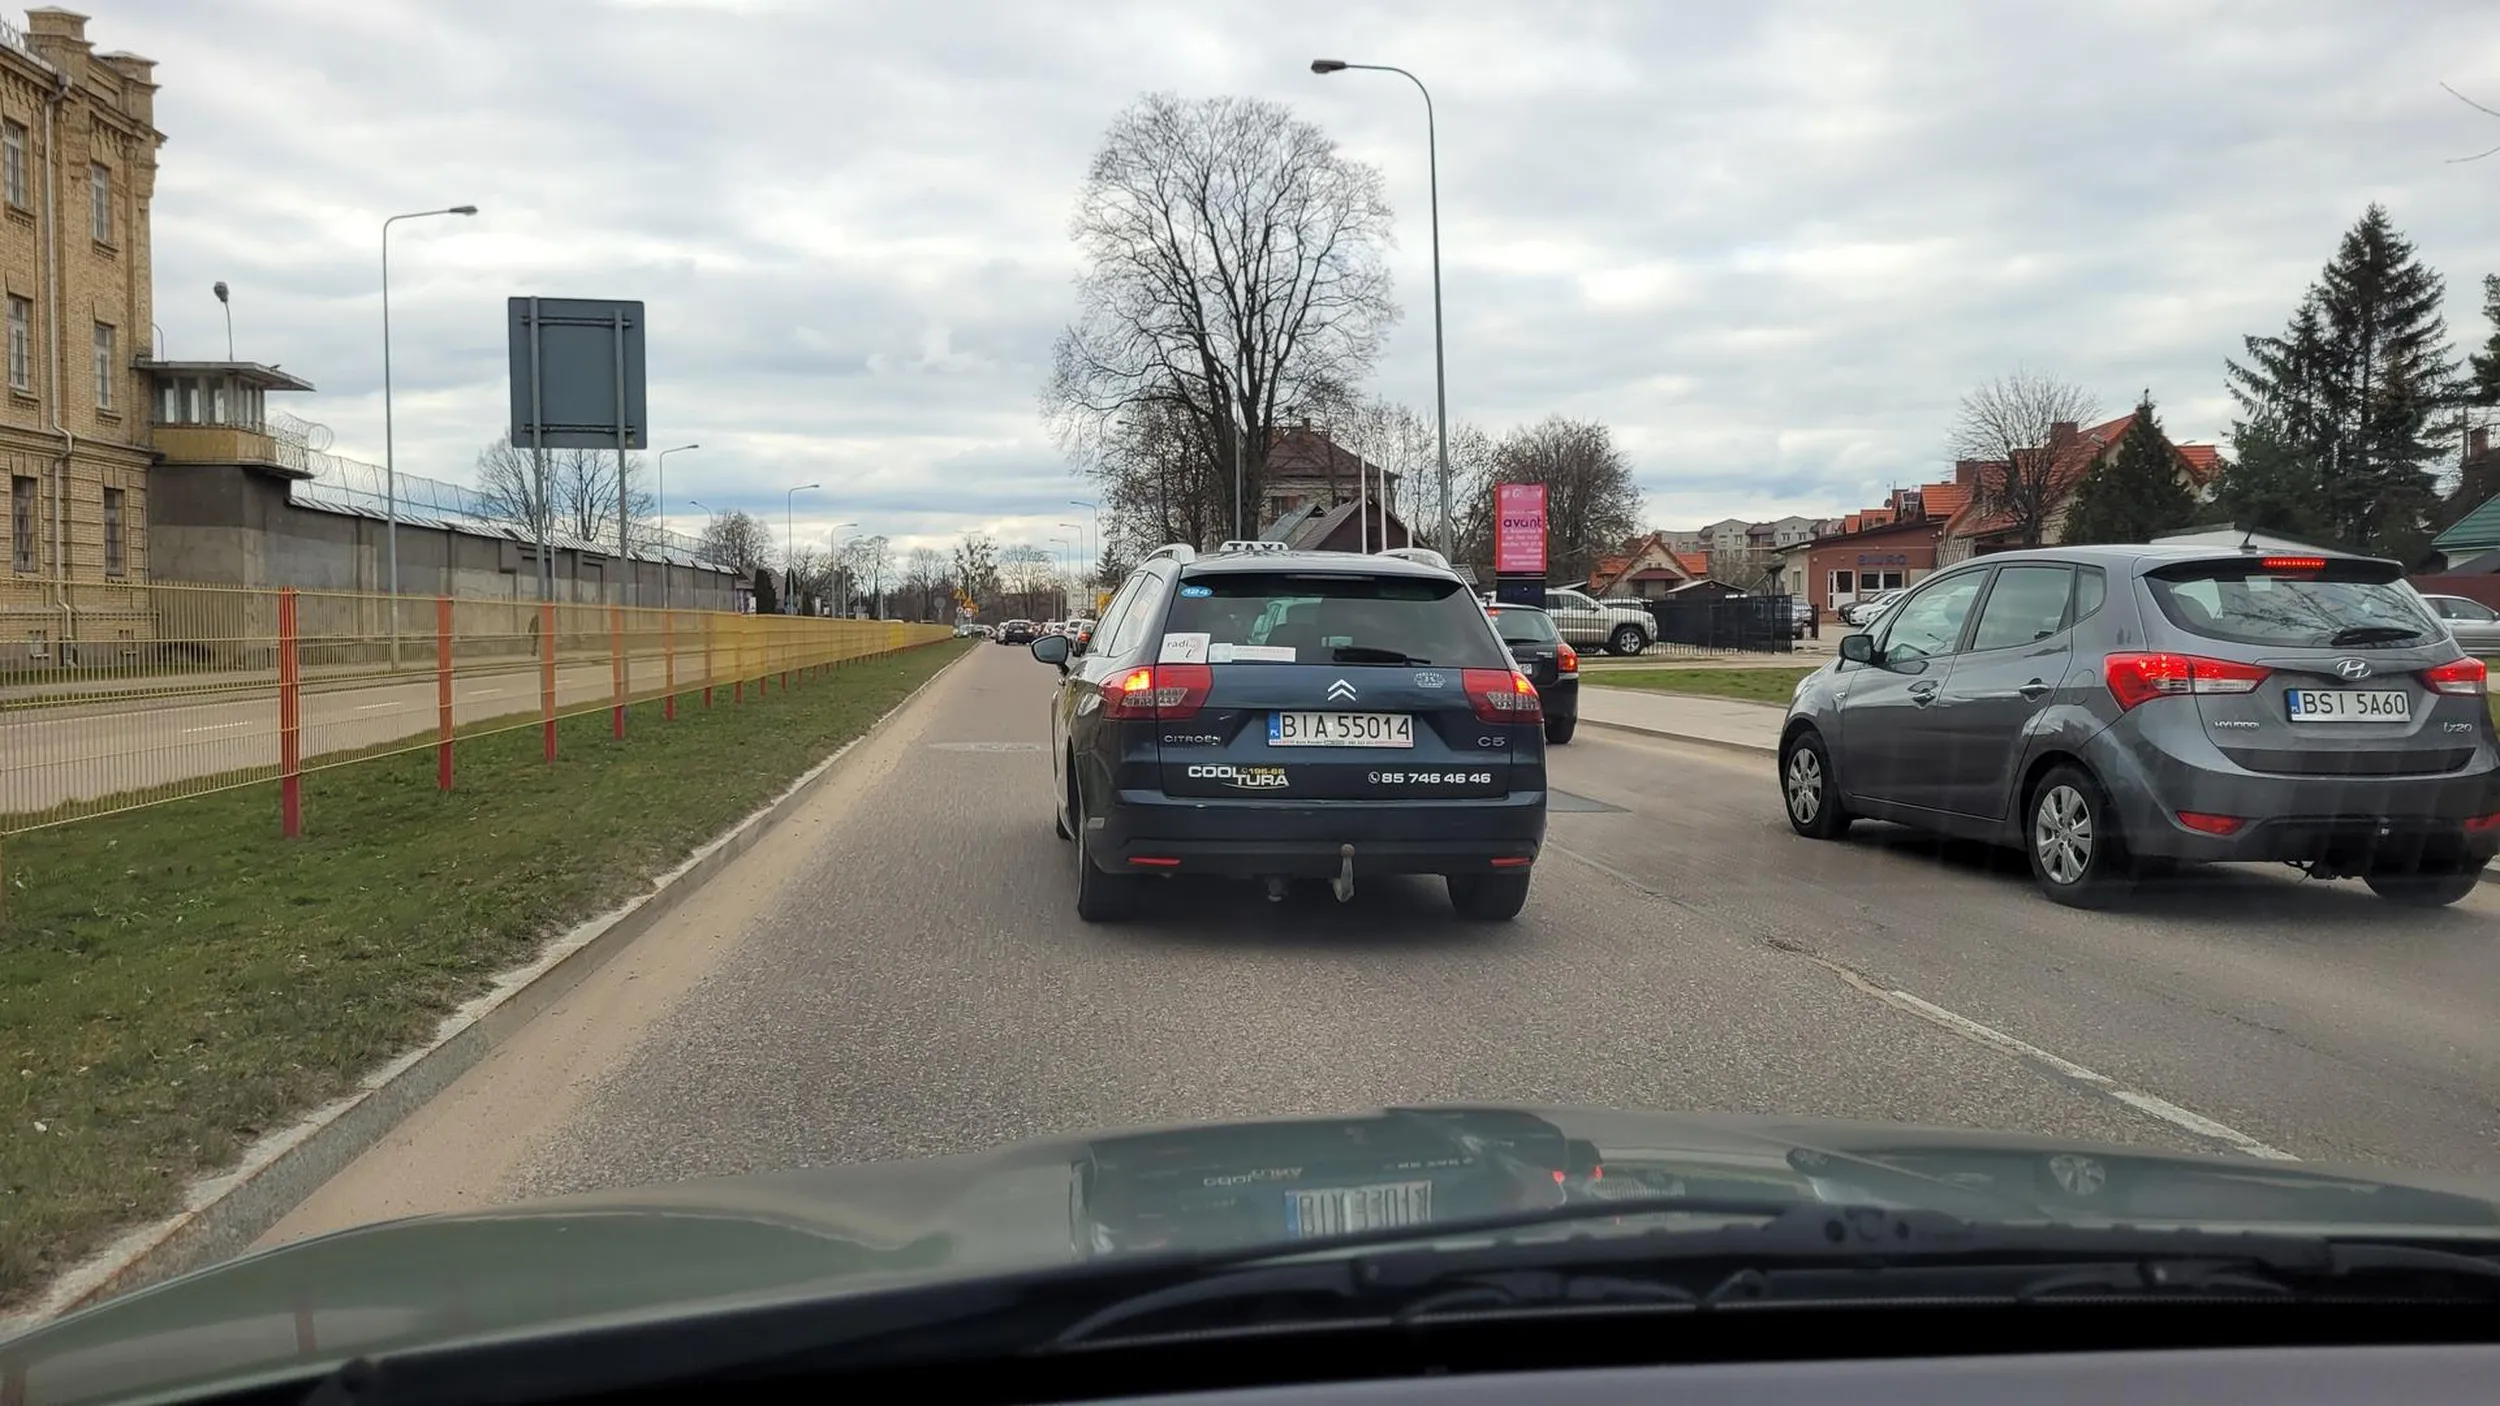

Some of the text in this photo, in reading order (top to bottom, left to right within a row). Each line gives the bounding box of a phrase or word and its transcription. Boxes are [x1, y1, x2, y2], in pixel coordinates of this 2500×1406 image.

[1503, 515, 1542, 528] avant
[2302, 692, 2406, 715] BSI 5A60
[1281, 714, 1411, 741] BIA 55014
[1477, 736, 1506, 747] C5
[1237, 775, 1290, 787] TURA
[1381, 773, 1492, 785] 85 746 46 46
